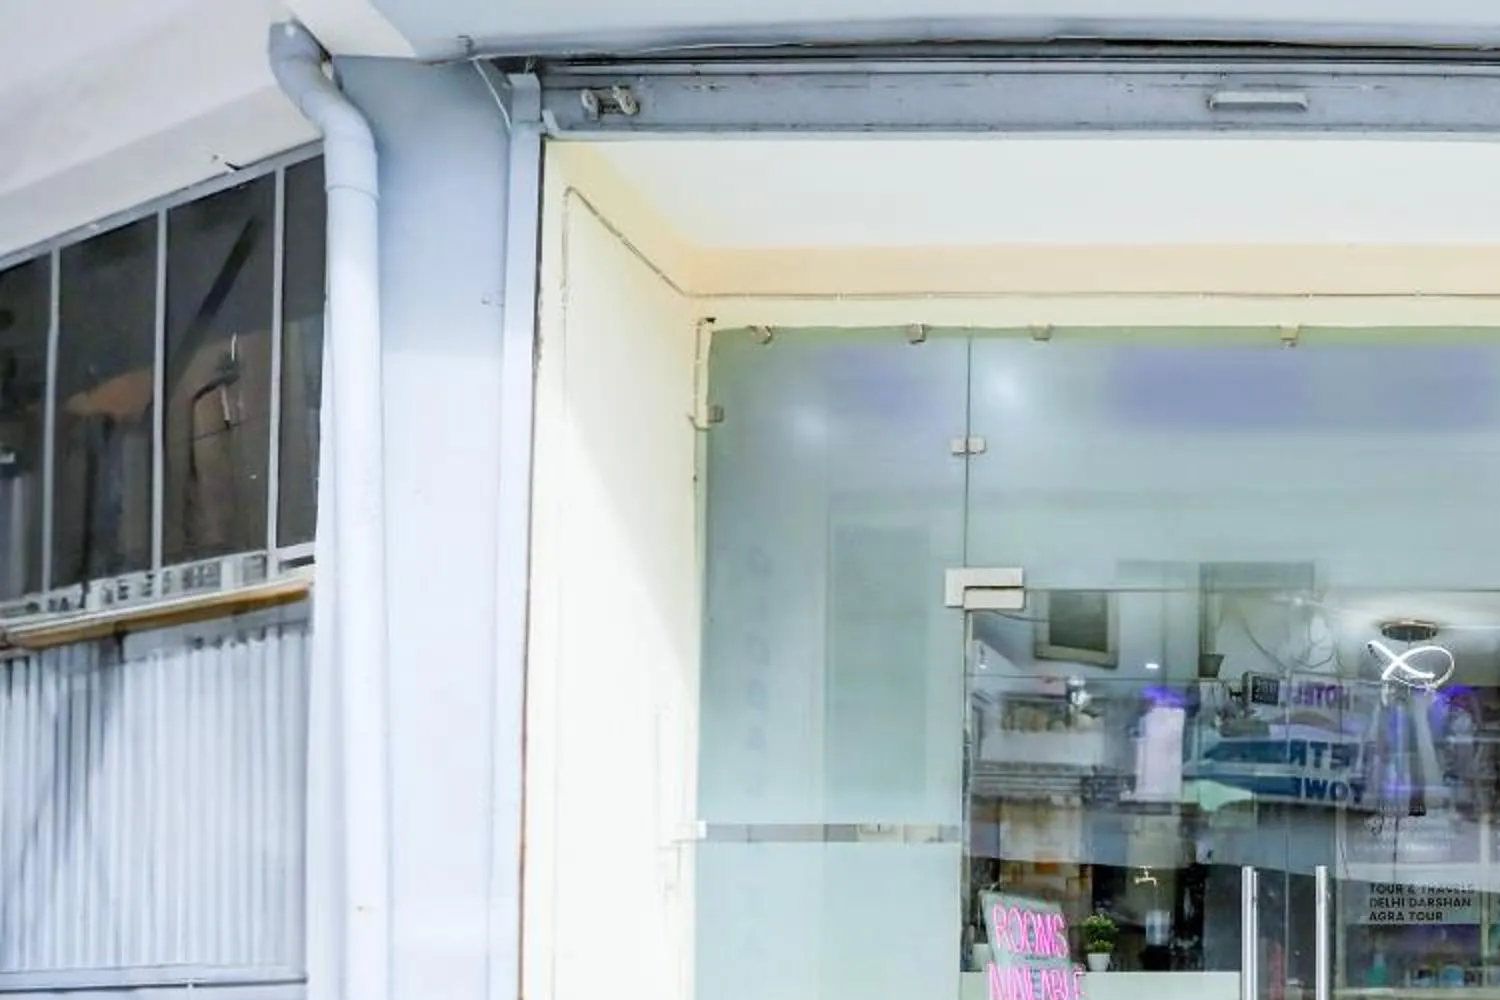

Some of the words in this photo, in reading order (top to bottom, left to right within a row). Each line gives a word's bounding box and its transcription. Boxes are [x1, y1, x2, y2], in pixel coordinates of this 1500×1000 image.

[1369, 883, 1402, 895] TOUR
[1369, 897, 1405, 908] DELHI
[1411, 897, 1471, 908] DARSHAN
[1369, 911, 1404, 921] AGRA
[1409, 911, 1443, 921] TOUR
[993, 904, 1070, 958] ROOMS
